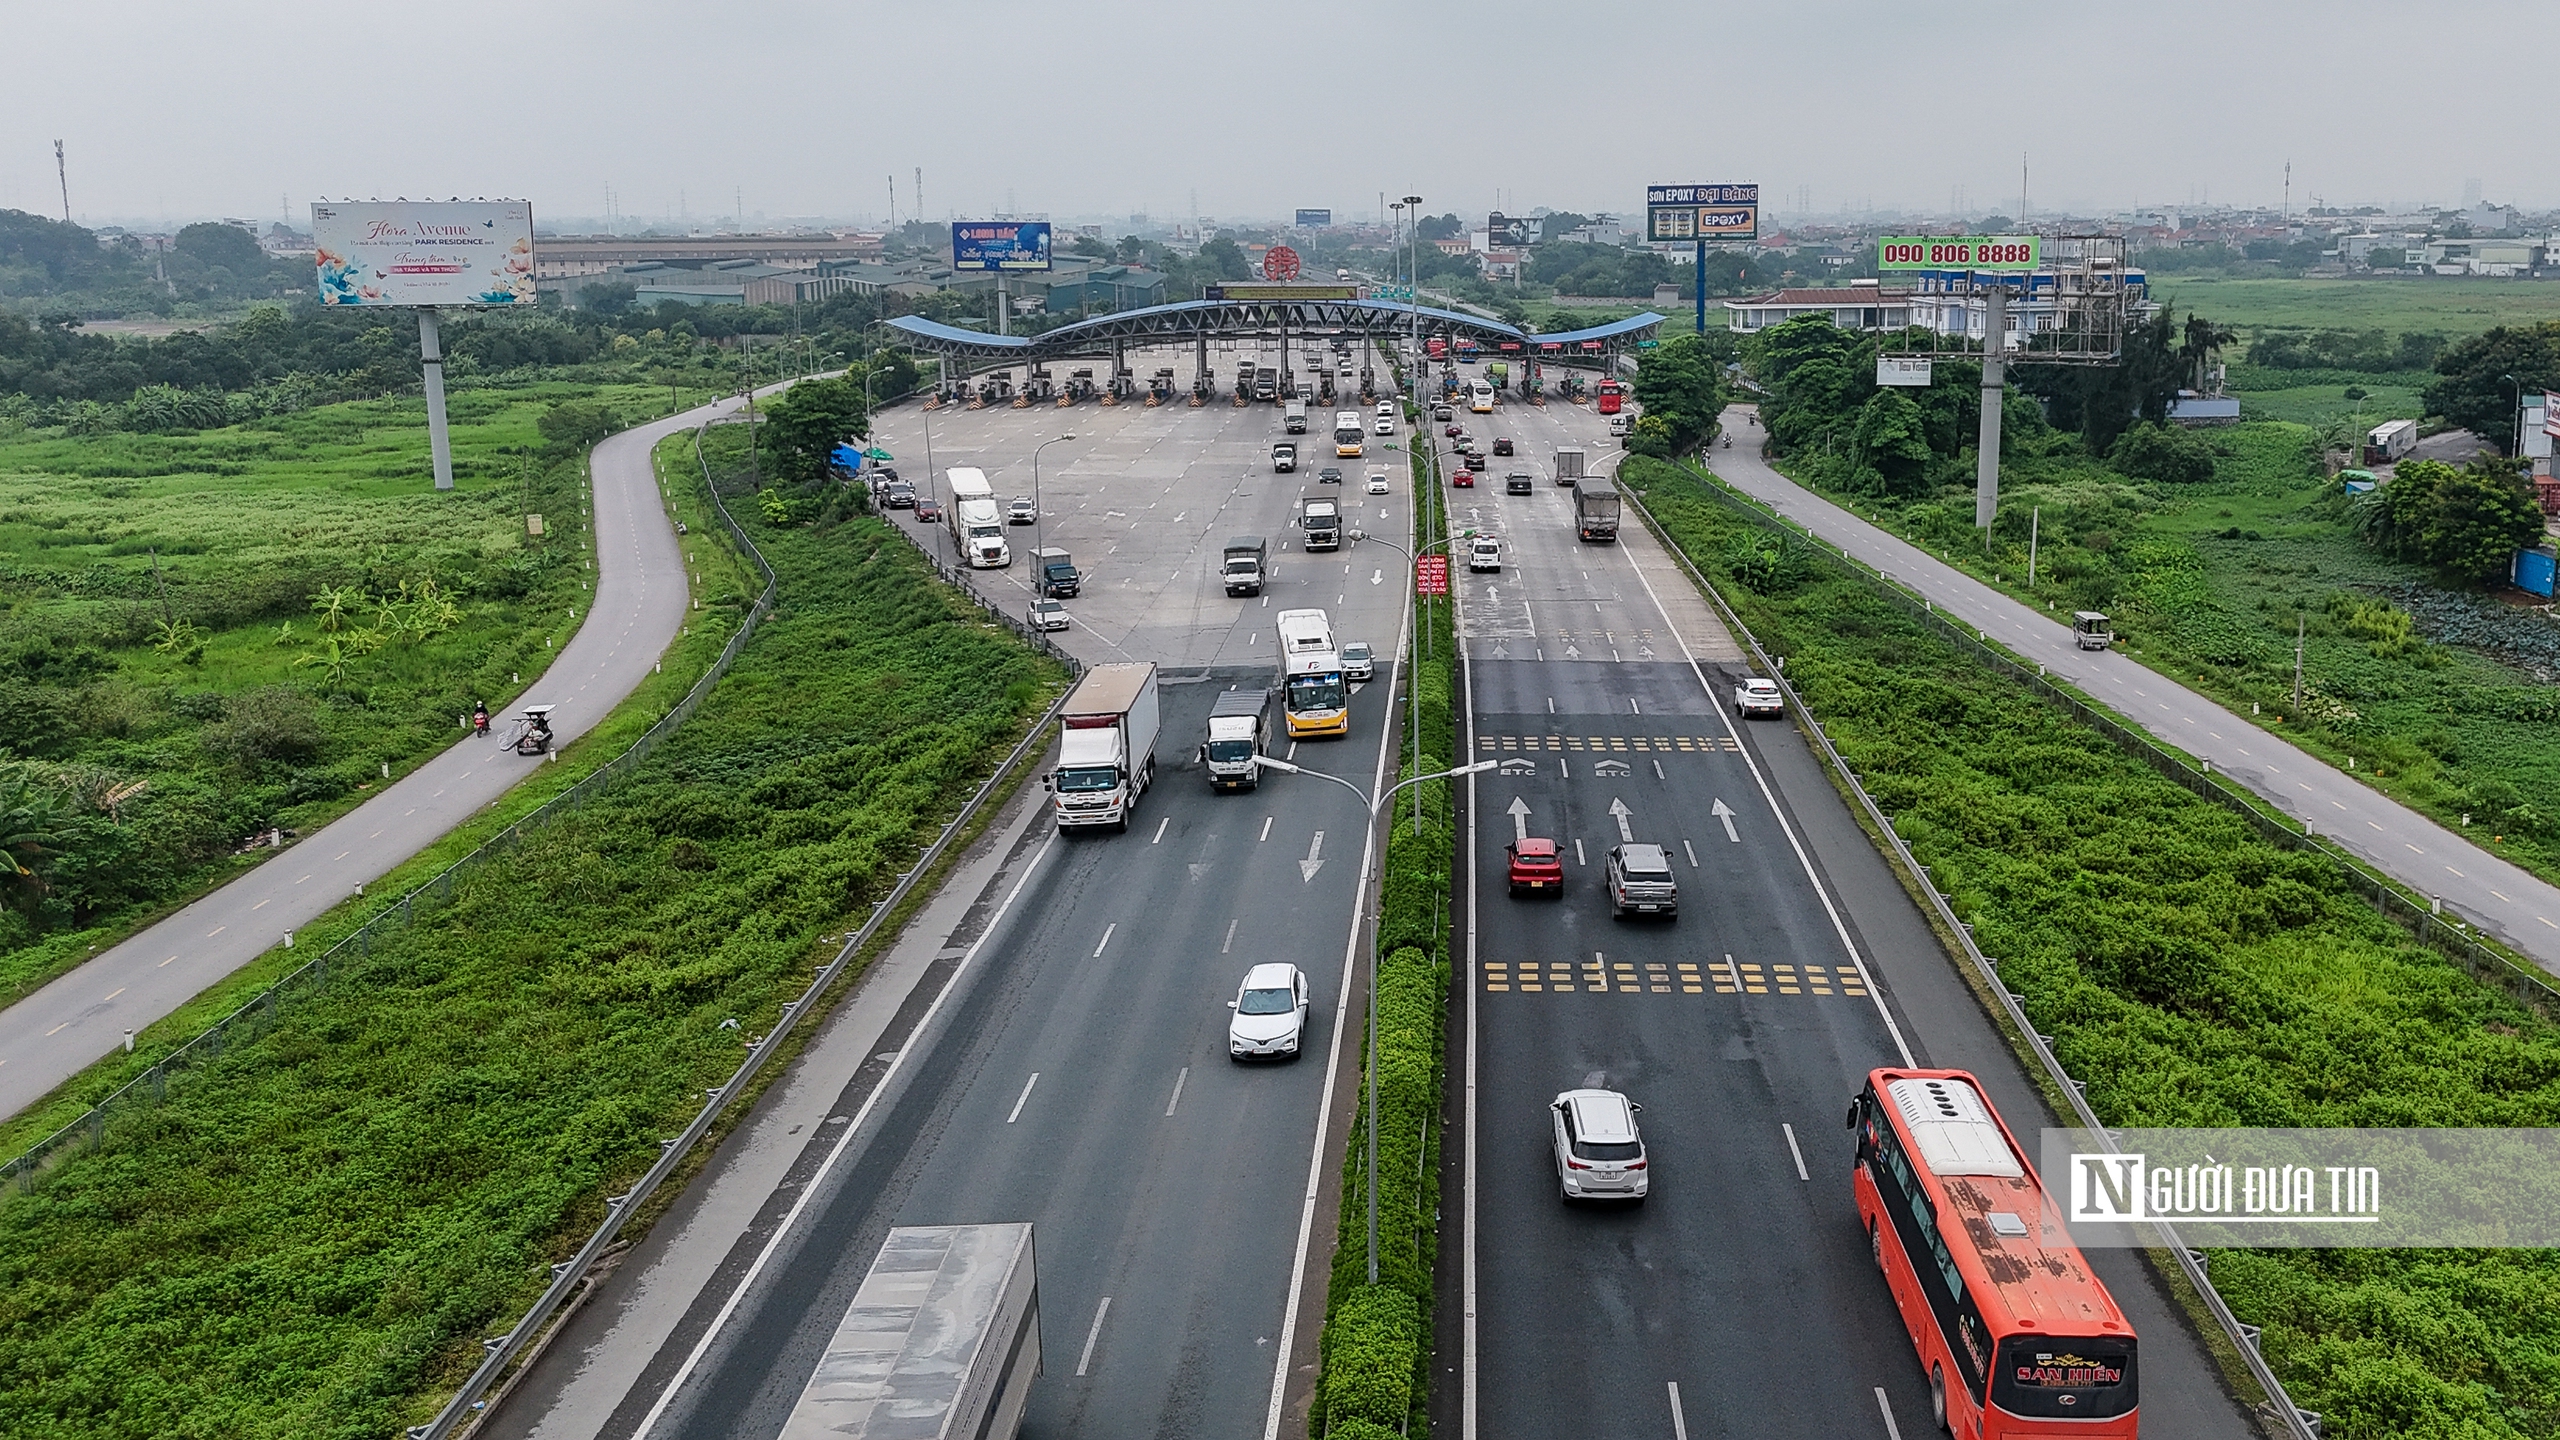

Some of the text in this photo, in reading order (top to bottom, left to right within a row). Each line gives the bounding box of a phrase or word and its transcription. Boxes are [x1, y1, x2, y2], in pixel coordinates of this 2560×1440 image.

[1666, 188, 1694, 202] EPOXY
[1705, 214, 1744, 226] EPOXY
[367, 219, 471, 239] Flora Avenue
[394, 252, 427, 266] Trung
[1884, 244, 2030, 262] 090 806 8888
[1595, 769, 1631, 777] ETC
[2017, 1367, 2062, 1381] SAN
